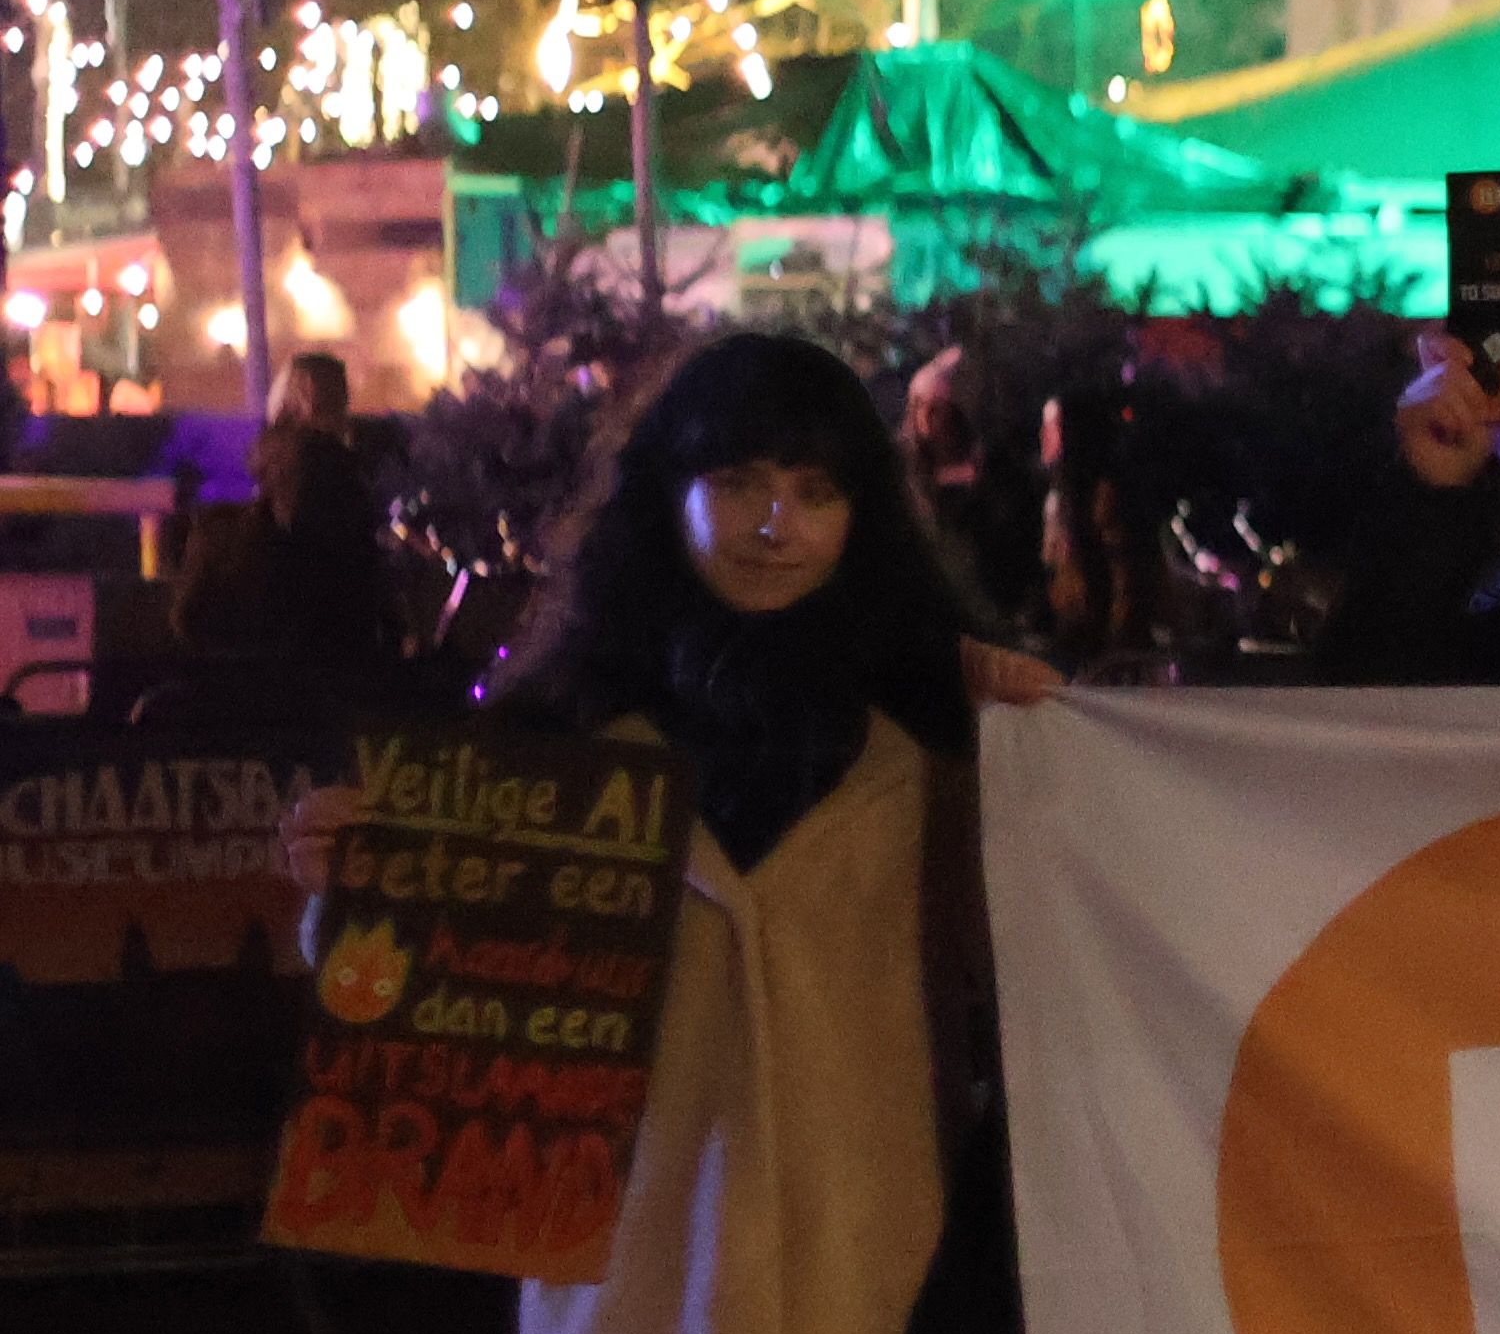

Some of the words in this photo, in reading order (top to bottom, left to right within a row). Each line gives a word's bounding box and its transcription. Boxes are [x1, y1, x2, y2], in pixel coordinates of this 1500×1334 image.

[354, 734, 560, 827] Veilige
[581, 765, 668, 845] AI
[548, 863, 656, 921] een
[525, 1006, 632, 1053] een
